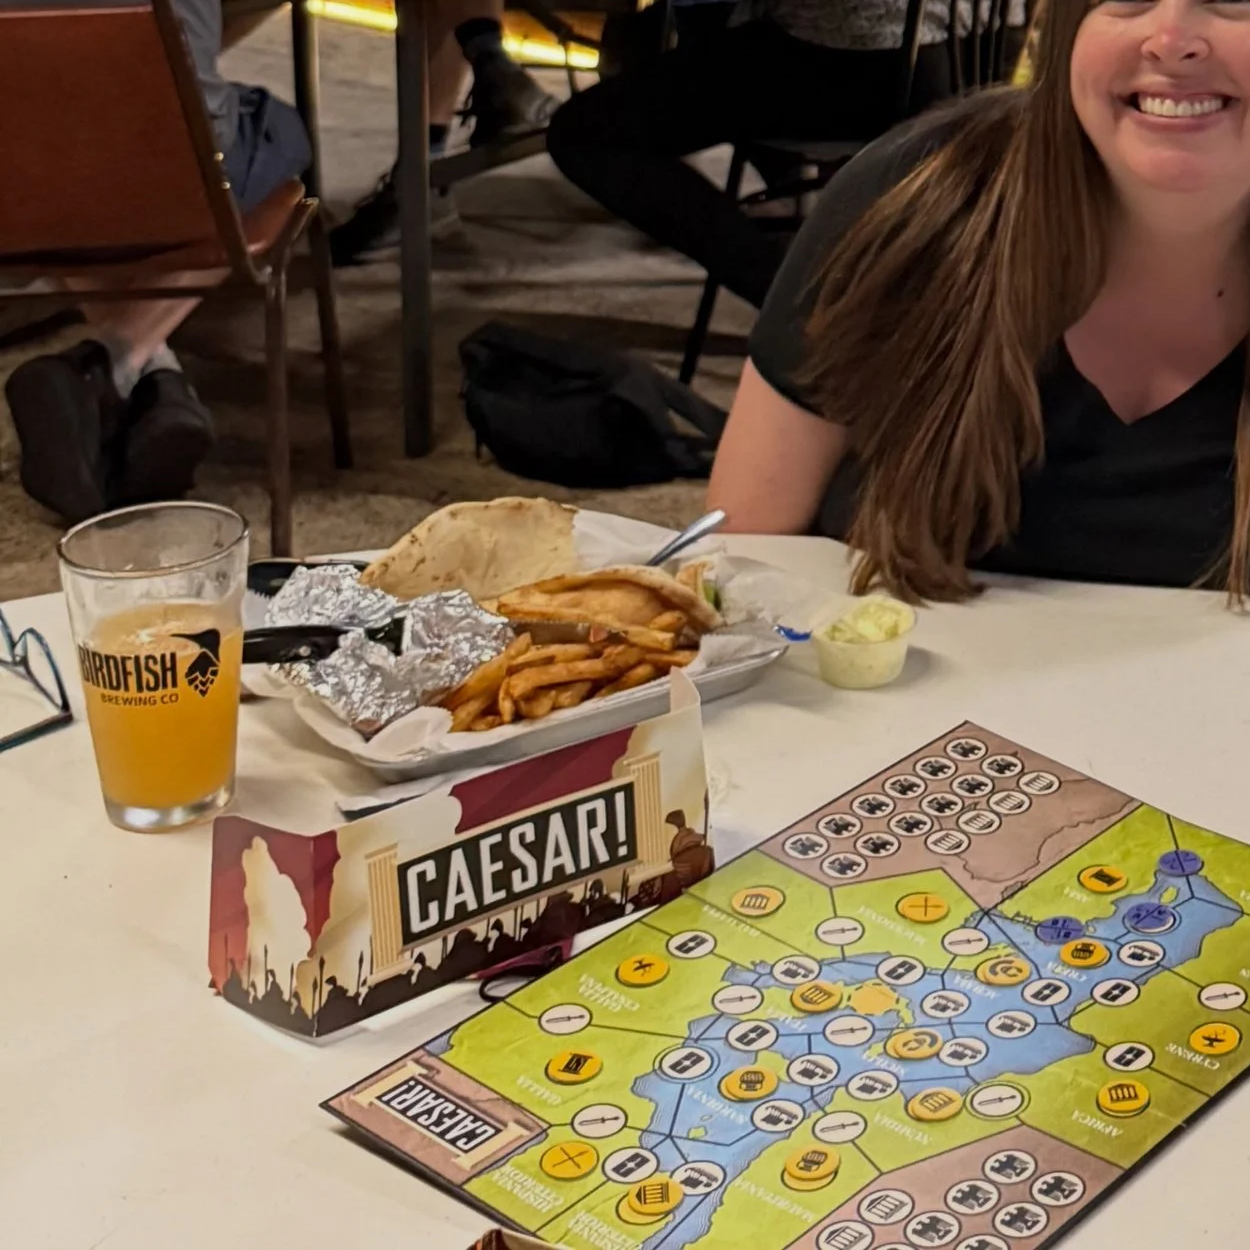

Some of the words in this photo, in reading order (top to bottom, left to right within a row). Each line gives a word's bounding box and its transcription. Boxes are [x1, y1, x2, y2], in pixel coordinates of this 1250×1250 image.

[78, 644, 178, 693] BIRDFISH
[101, 693, 157, 707] BREWING
[160, 693, 179, 705] CO
[406, 790, 629, 934] CAESAR!
[376, 1078, 501, 1151] CAESAR!
[1067, 1108, 1123, 1139] AFRICA
